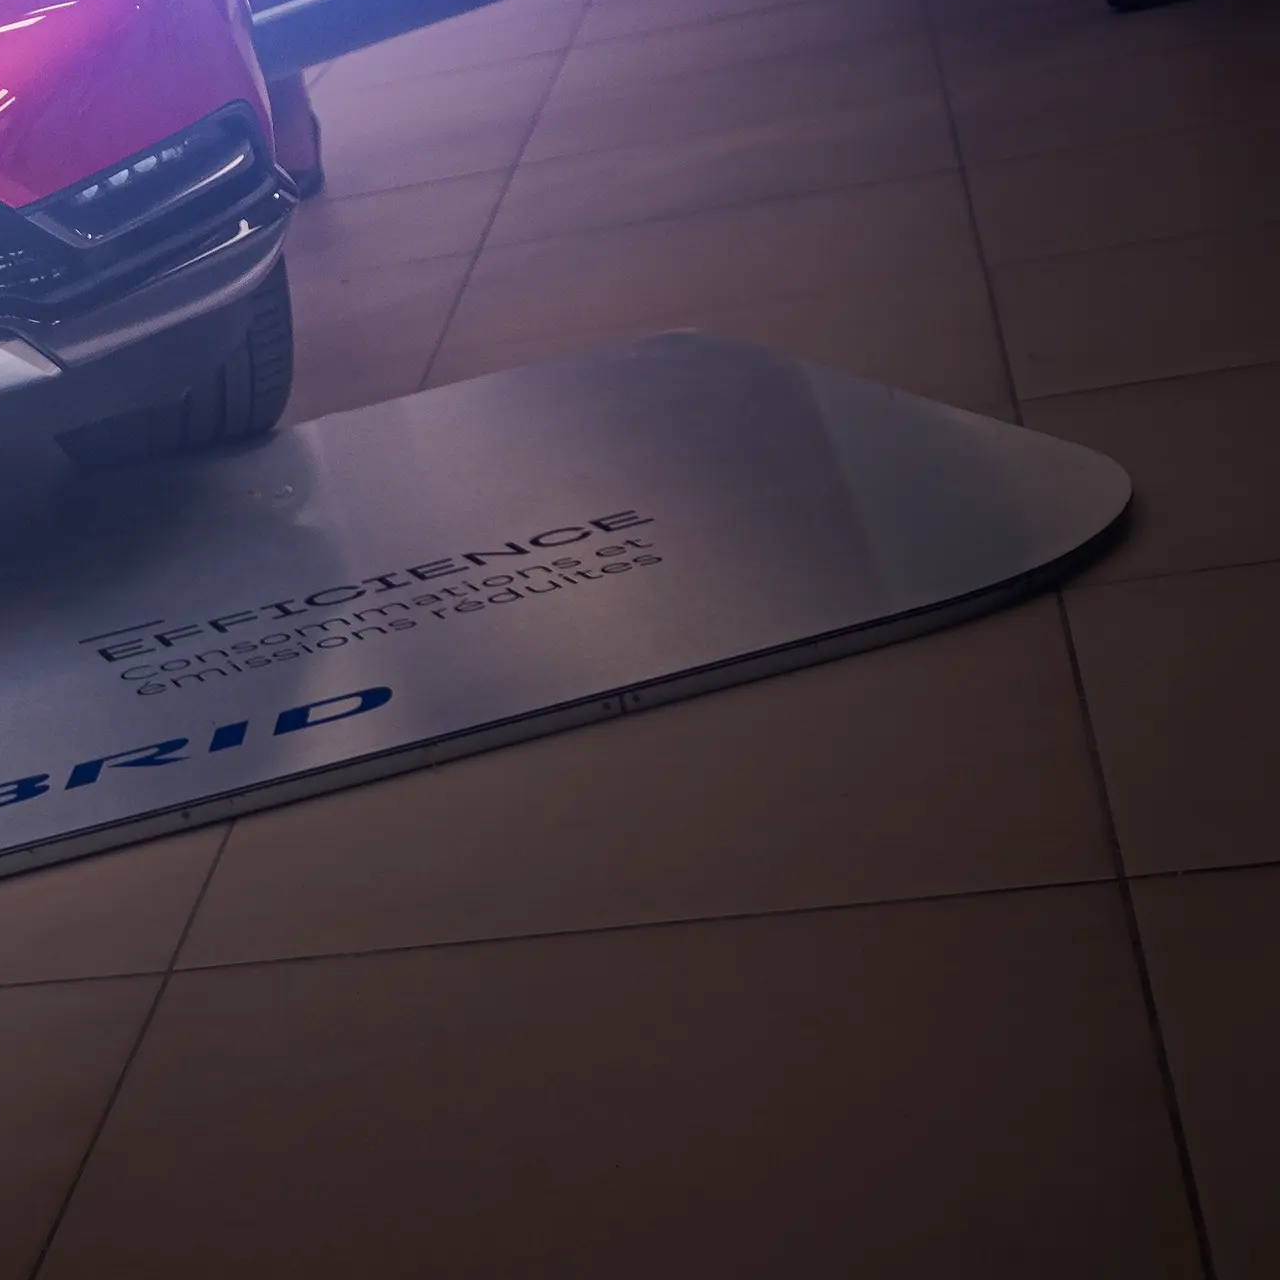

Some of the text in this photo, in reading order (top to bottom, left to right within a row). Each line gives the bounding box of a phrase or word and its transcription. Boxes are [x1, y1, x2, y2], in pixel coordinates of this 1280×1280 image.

[97, 510, 655, 663] EFFICIENCE
[120, 537, 655, 682] Consommations et
[136, 551, 664, 696] émissions réduites
